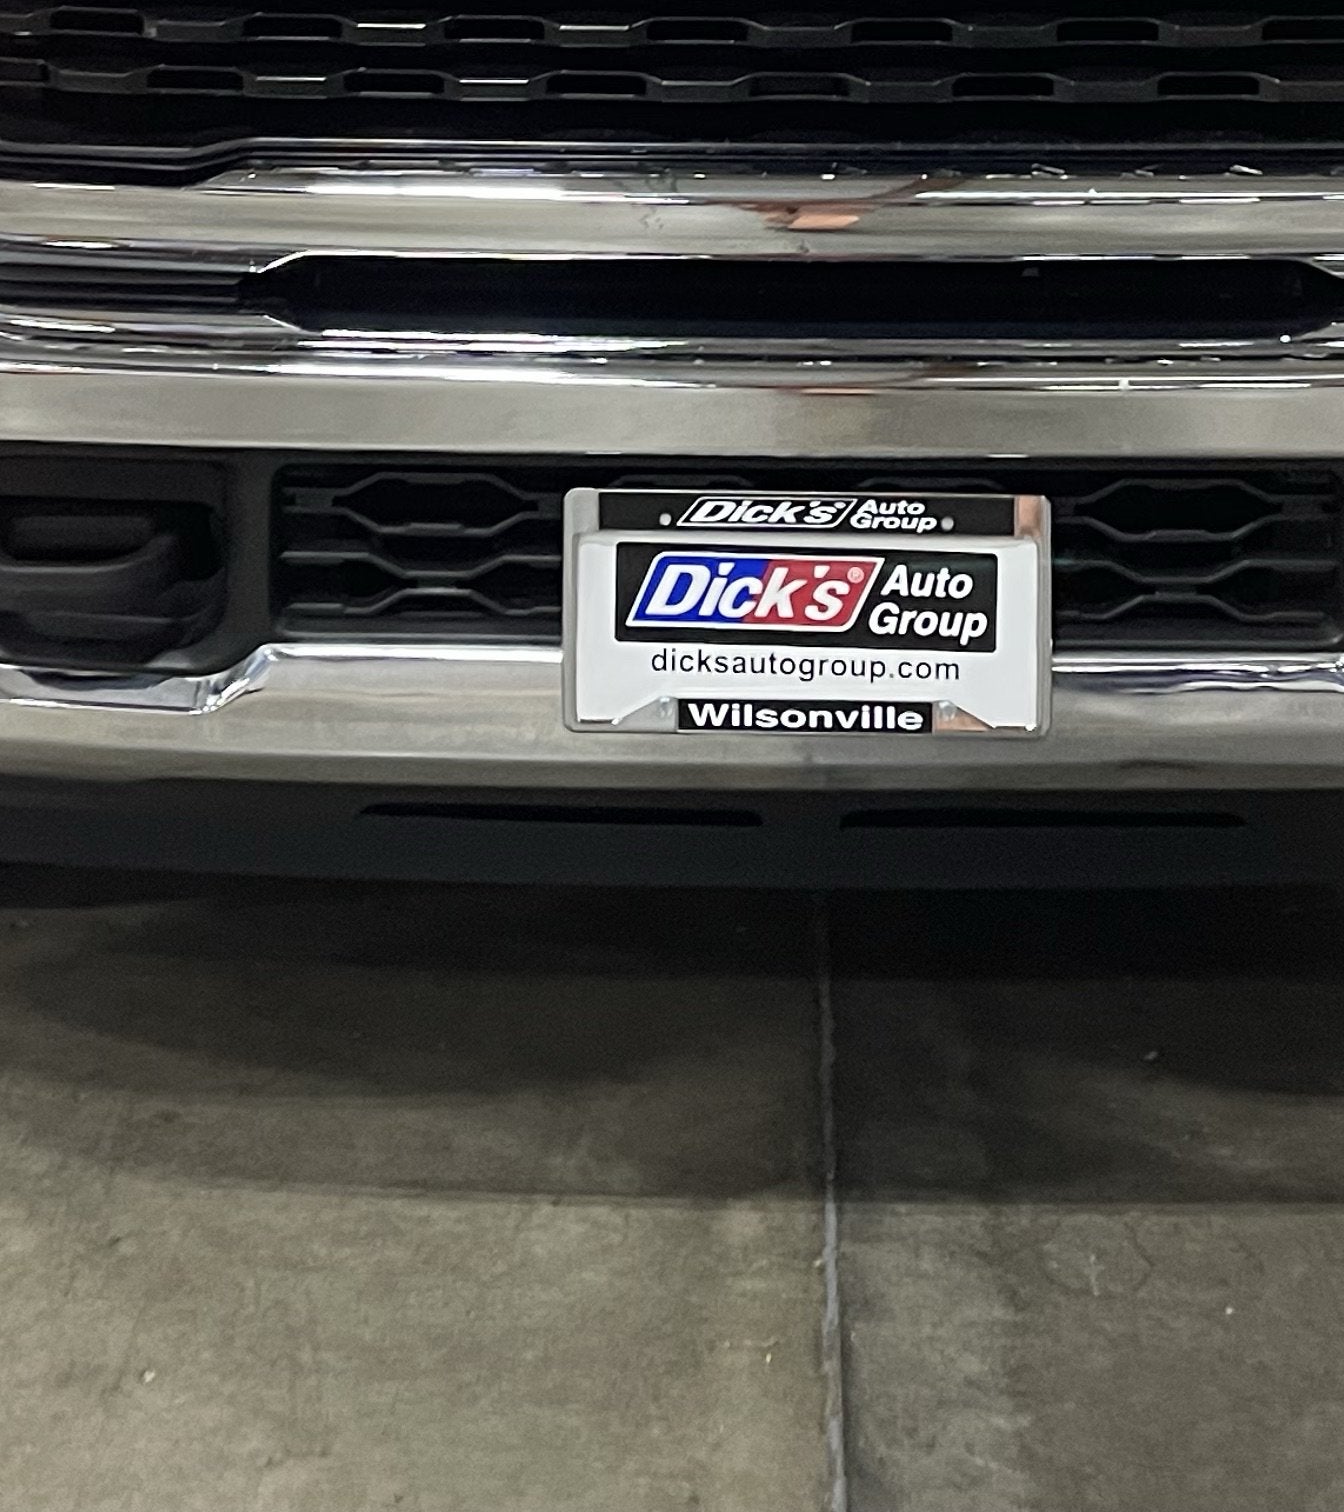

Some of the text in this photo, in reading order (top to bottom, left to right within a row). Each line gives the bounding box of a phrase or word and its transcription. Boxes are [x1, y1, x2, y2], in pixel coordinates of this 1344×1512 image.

[689, 499, 838, 524] Dick's
[856, 499, 926, 516] Auto
[849, 513, 938, 534] Group
[644, 561, 851, 621] Dick's
[880, 563, 974, 599] Auto
[867, 602, 989, 646] Group
[650, 648, 961, 683] dicksautogroup.com
[687, 702, 924, 730] Wilsonville
